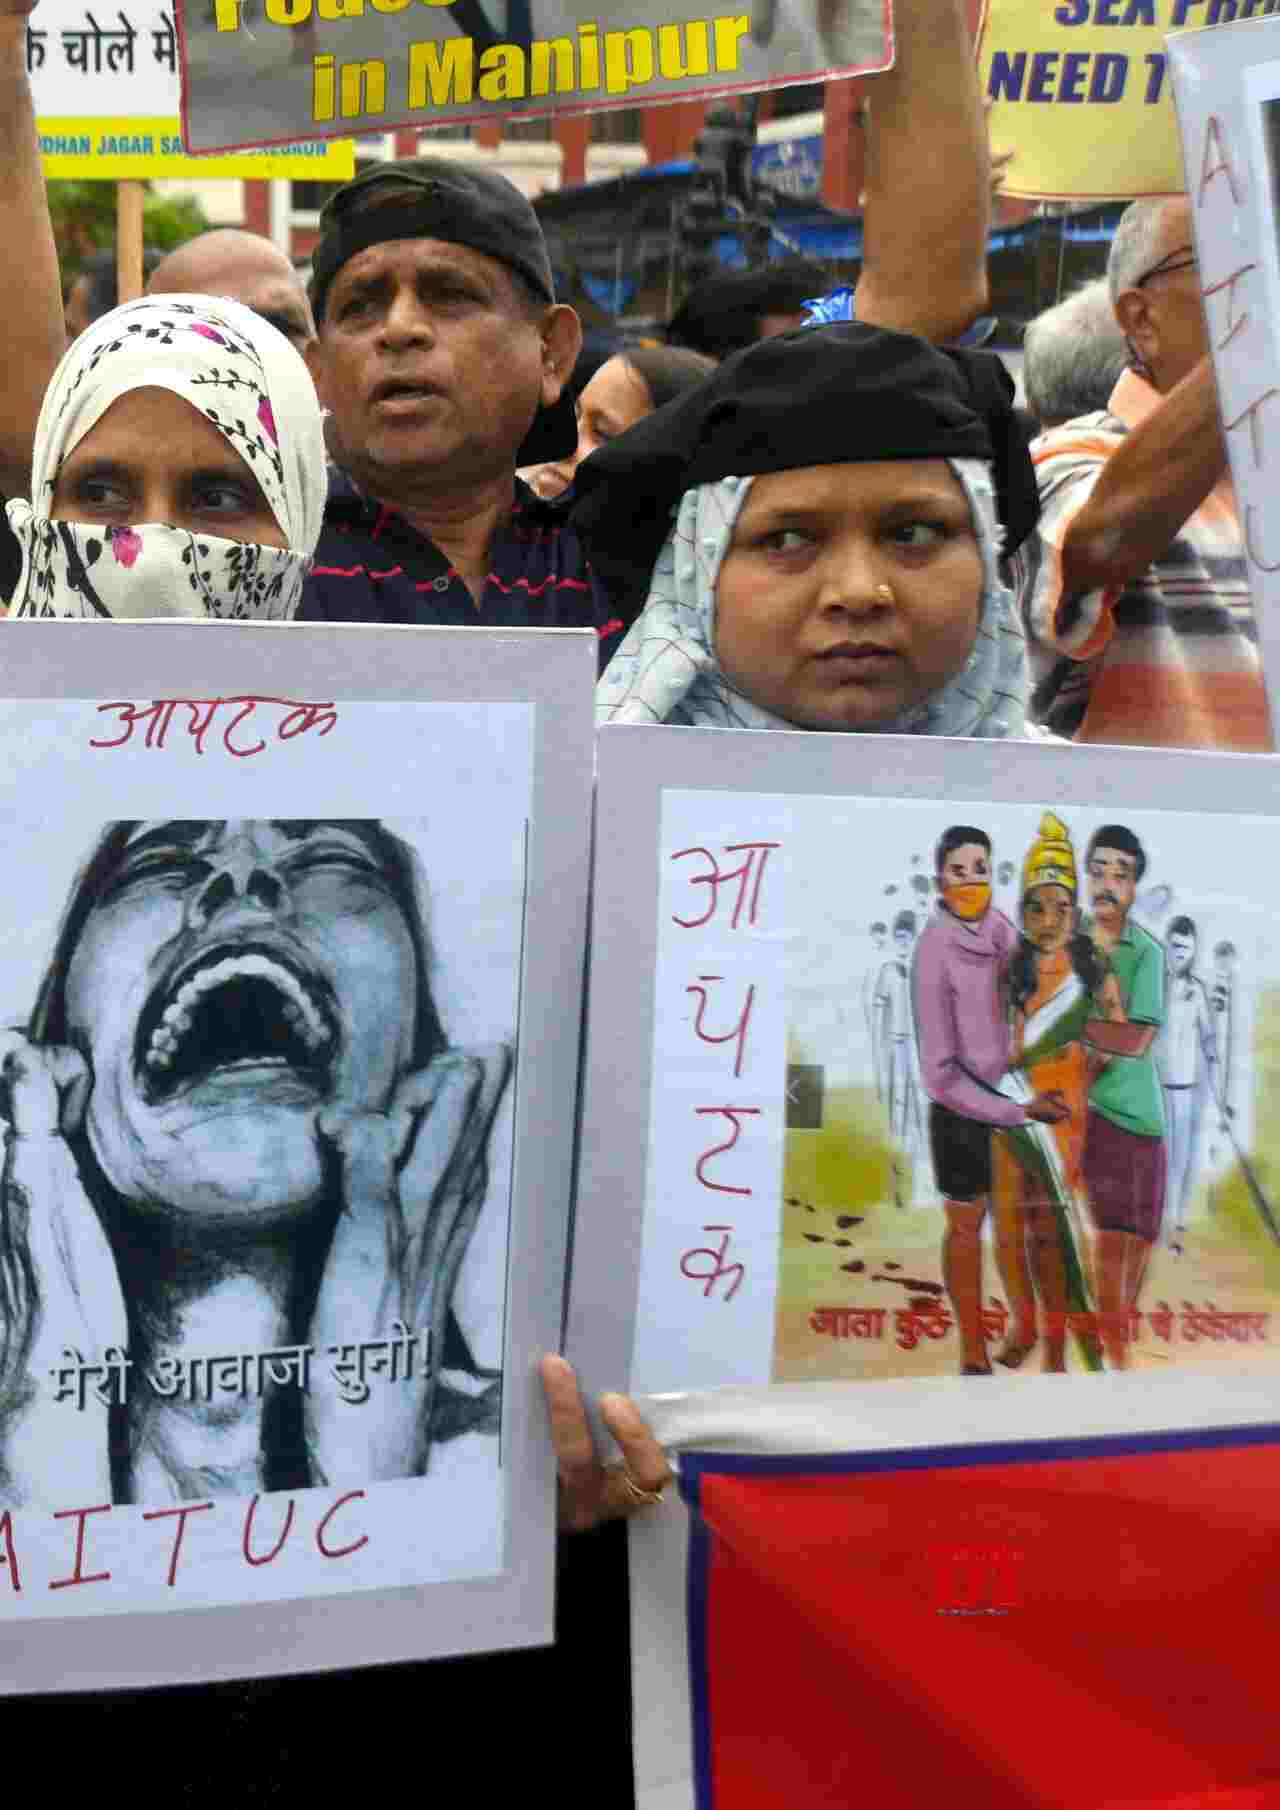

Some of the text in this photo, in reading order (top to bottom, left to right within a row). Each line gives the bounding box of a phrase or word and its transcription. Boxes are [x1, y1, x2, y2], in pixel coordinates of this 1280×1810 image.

[61, 11, 137, 73] चोले
[311, 14, 752, 121] in Manipur
[988, 51, 1128, 103] NEED
[50, 1321, 434, 1410] मेरी आवाज सुनो!
